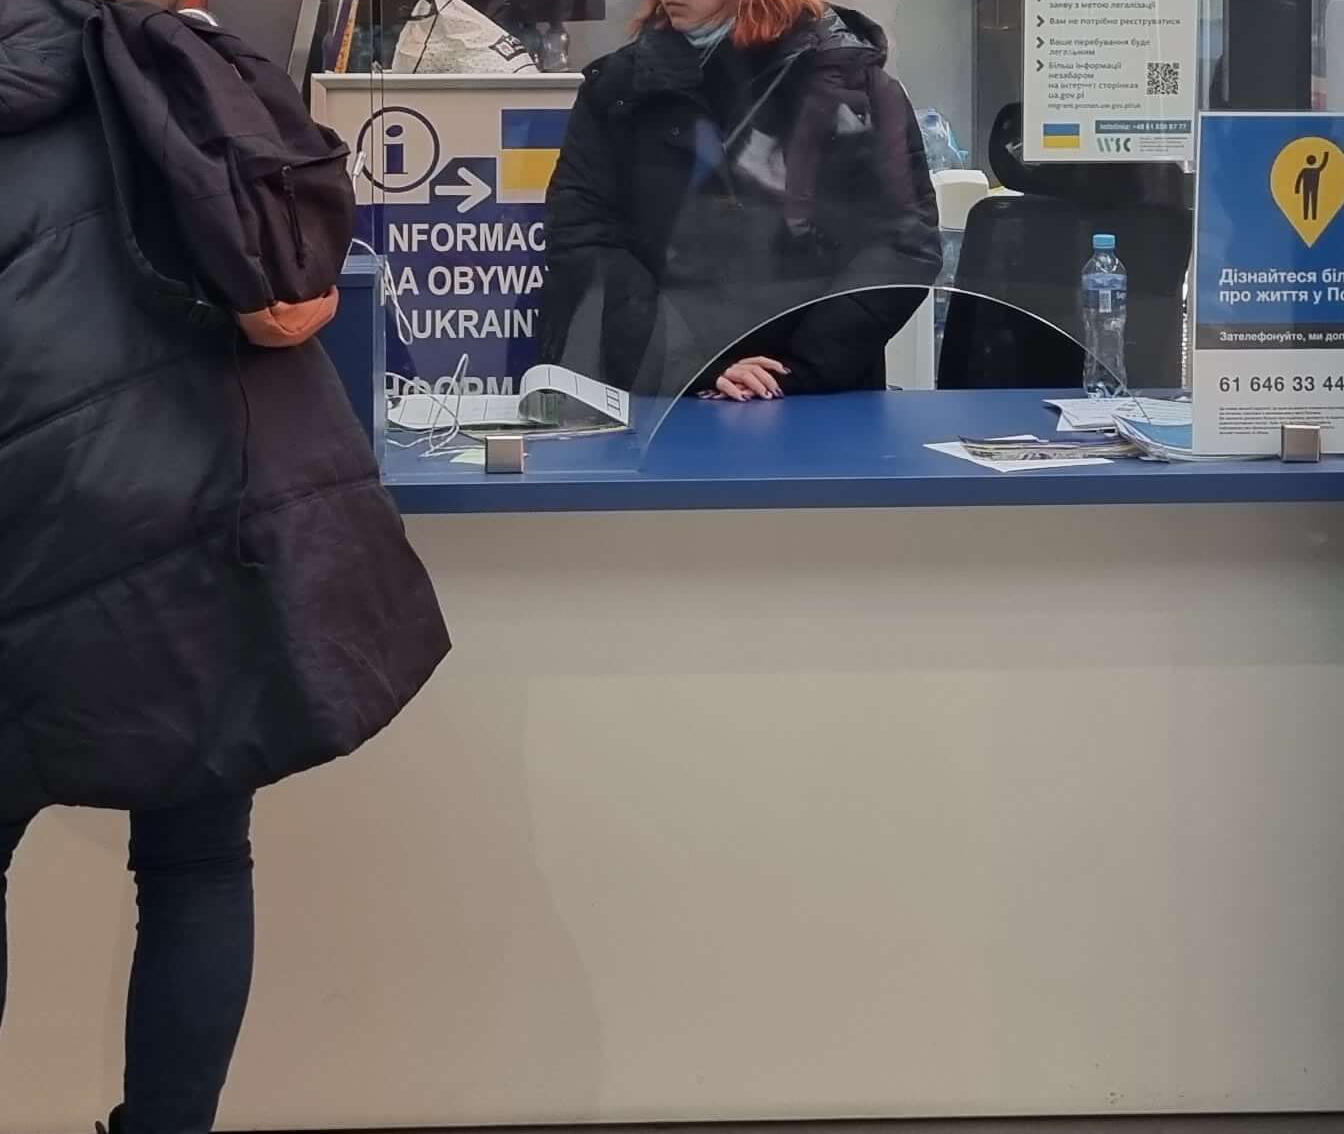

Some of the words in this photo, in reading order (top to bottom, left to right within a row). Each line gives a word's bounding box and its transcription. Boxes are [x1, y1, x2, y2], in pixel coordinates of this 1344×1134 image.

[388, 222, 546, 252] NFORMAC
[427, 266, 550, 295] OBYWA
[1218, 268, 1317, 286] Дізнайтеся
[1219, 290, 1252, 305] про
[1256, 290, 1309, 302] життя
[1312, 290, 1323, 305] у
[411, 309, 539, 339] UKRAIN
[1219, 376, 1240, 392] 61
[1250, 376, 1285, 392] 646
[1292, 376, 1315, 392] 33
[1322, 376, 1344, 392] 44
